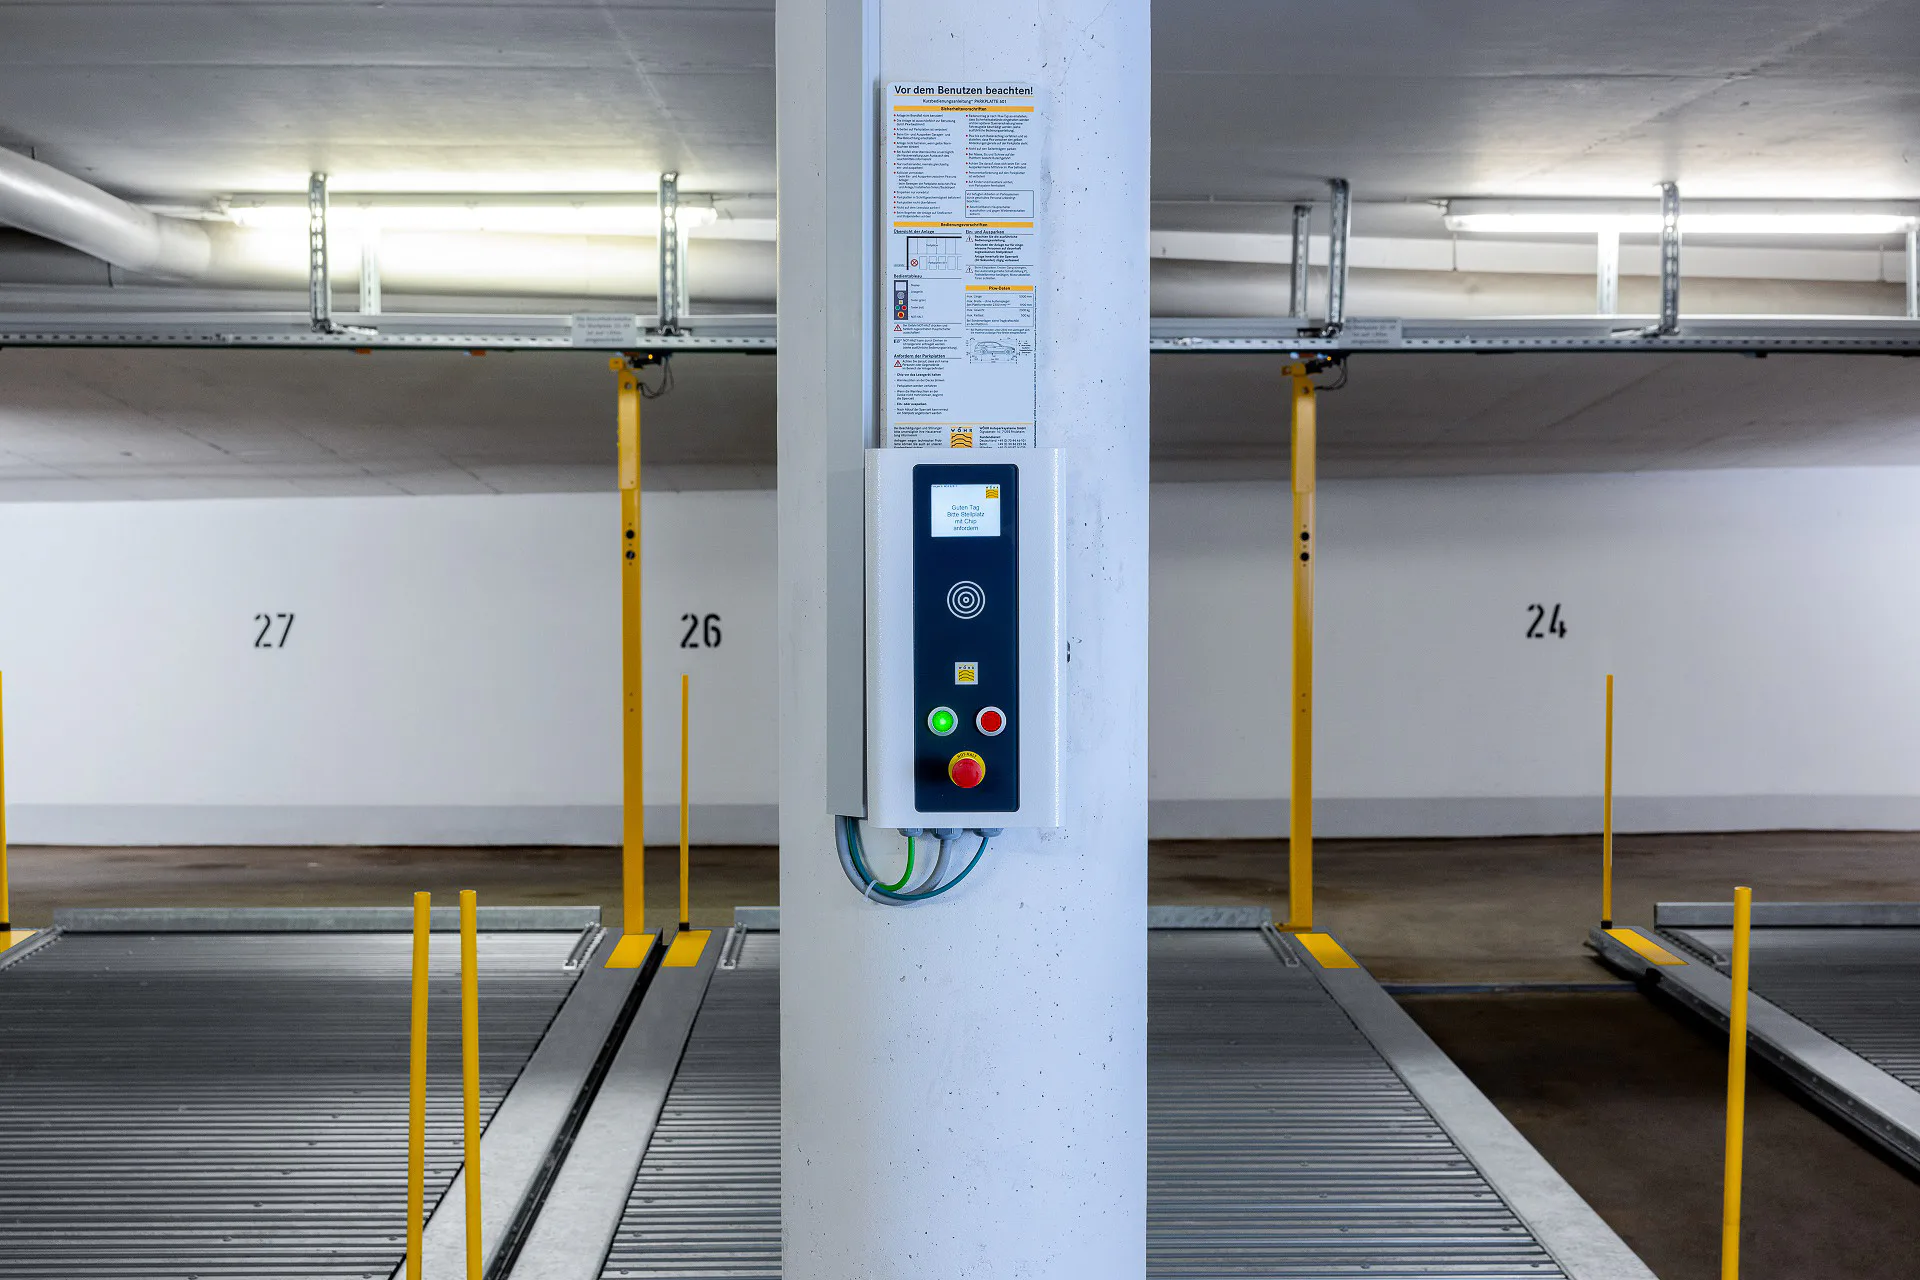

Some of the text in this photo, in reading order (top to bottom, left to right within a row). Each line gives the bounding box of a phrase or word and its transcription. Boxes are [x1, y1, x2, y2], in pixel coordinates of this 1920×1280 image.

[894, 85, 1033, 95] Vor dem Benutzen beachten!
[255, 613, 294, 648] 27
[681, 613, 721, 648] 26
[1527, 603, 1567, 638] 24
